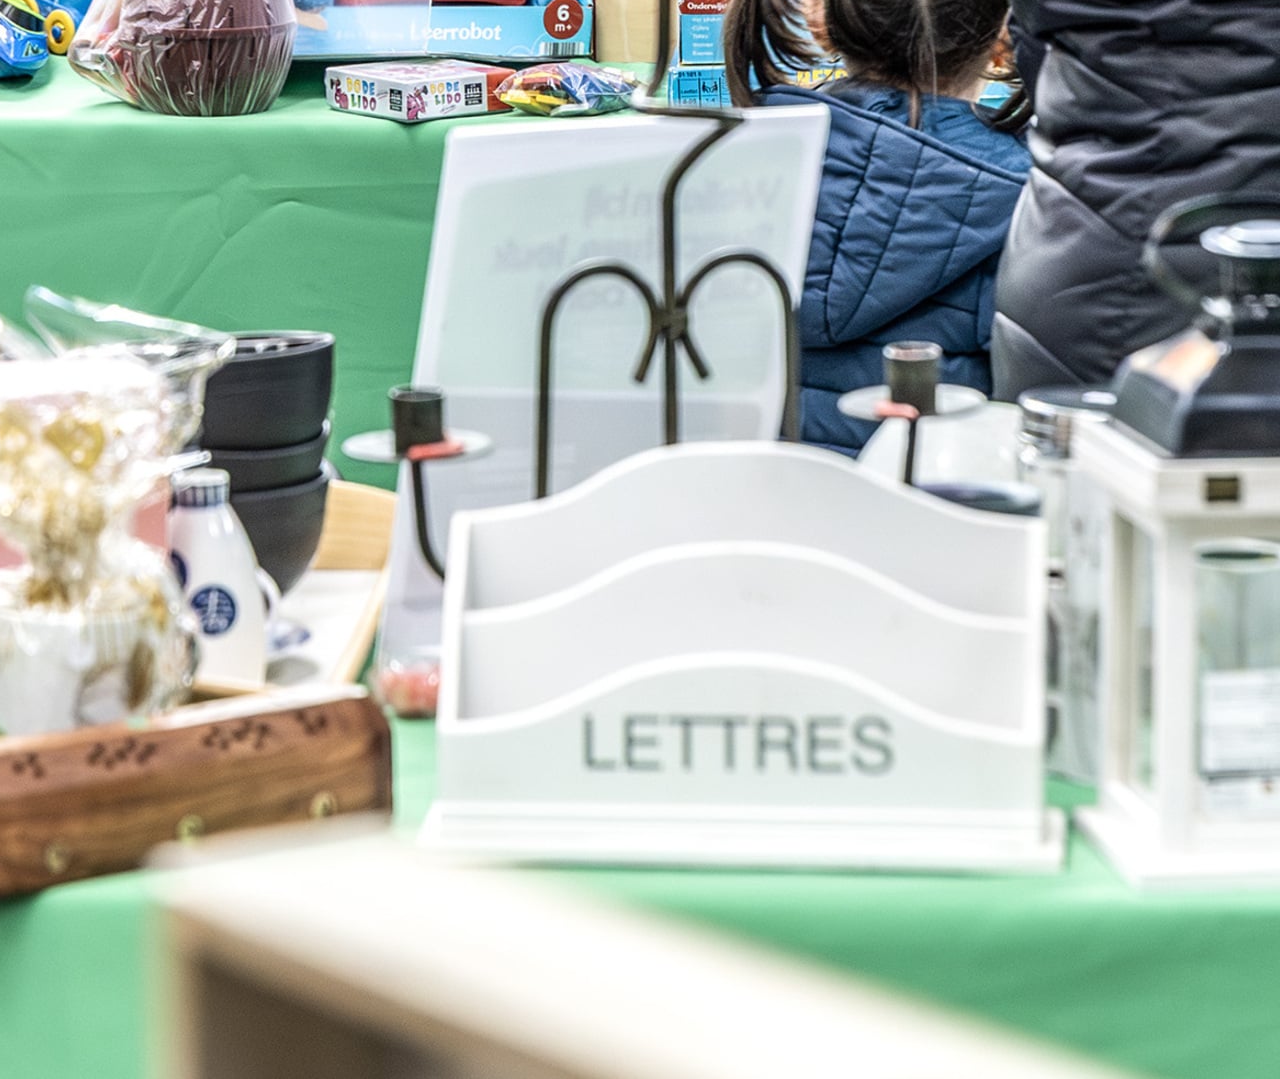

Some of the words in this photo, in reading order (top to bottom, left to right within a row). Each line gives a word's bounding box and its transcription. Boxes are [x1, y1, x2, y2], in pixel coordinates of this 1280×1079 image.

[556, 4, 570, 22] 6
[410, 21, 502, 42] Leerrobot
[351, 93, 376, 111] LIDO
[435, 92, 461, 105] LIDO
[581, 713, 895, 776] LETTRES
